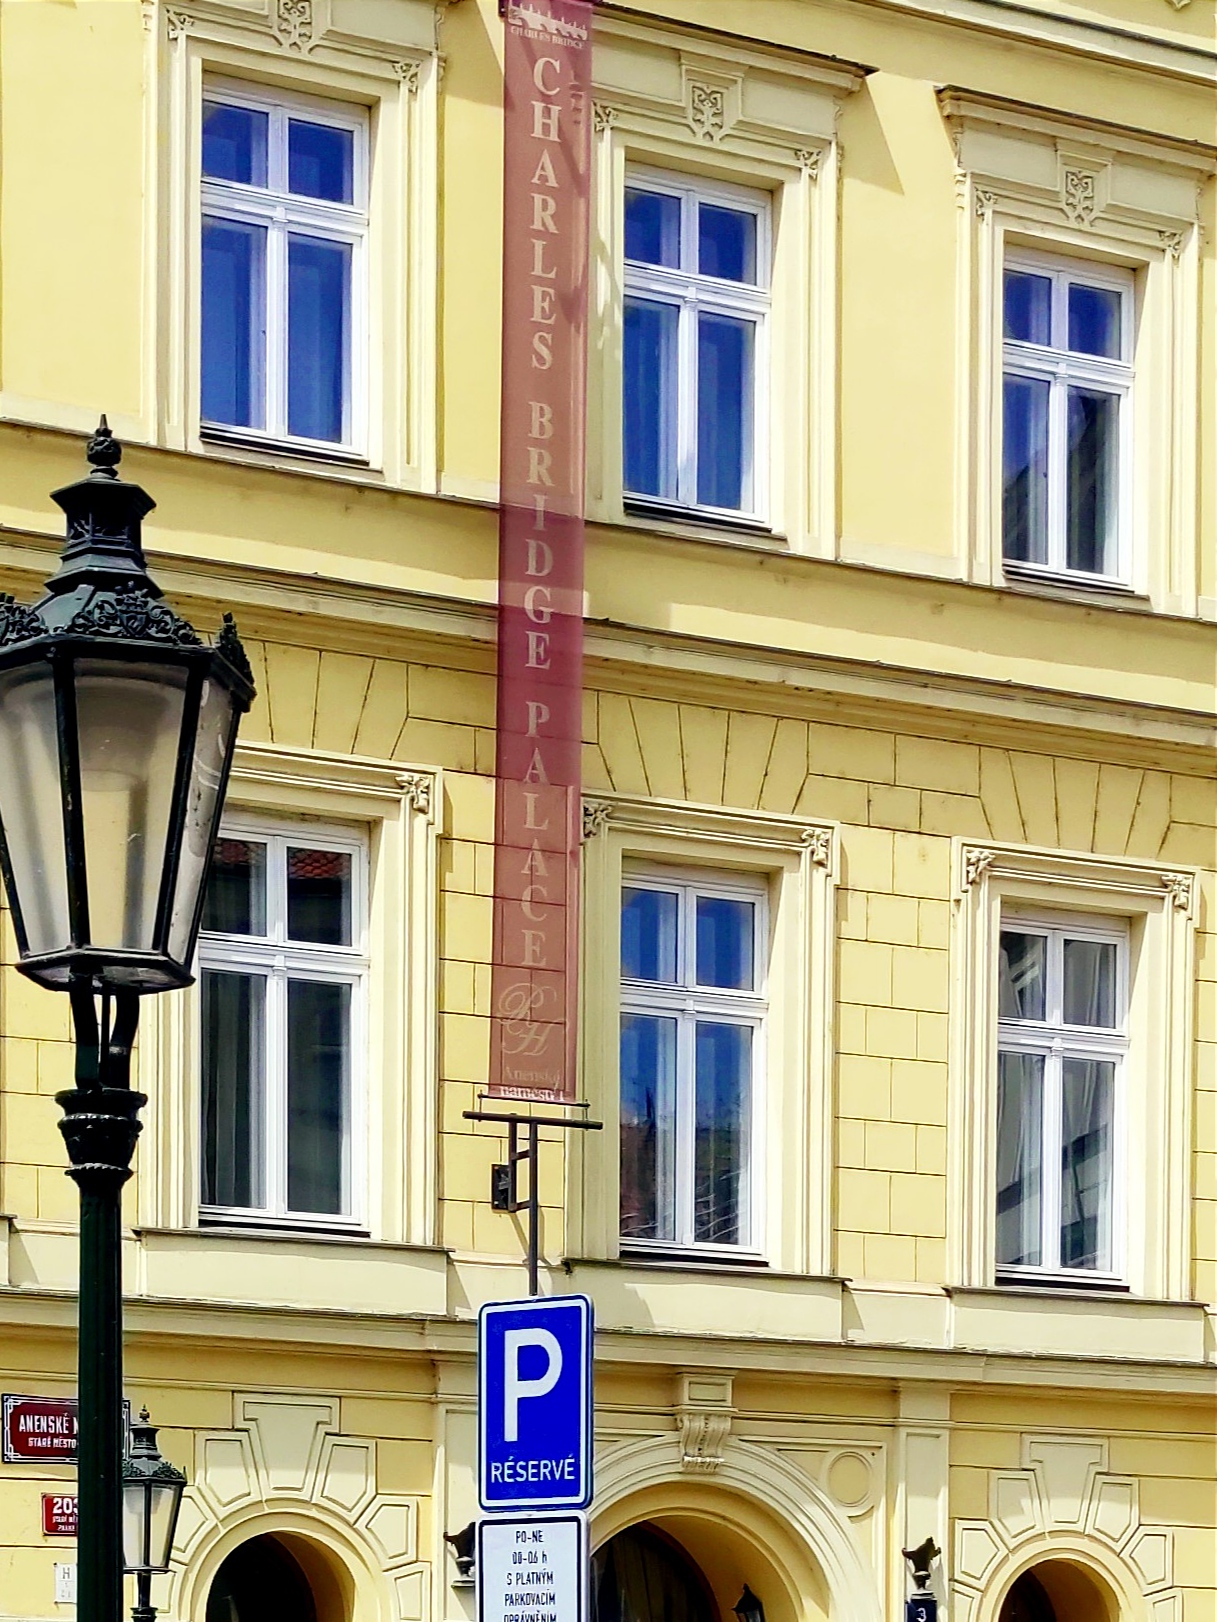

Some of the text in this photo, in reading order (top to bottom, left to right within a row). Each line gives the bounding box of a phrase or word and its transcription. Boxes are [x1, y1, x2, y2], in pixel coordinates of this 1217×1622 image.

[521, 57, 562, 967] CHARLES BRIDGE PALACE
[504, 1327, 563, 1442] P
[18, 1412, 70, 1435] ANENSKÉ
[491, 1453, 575, 1484] RÉSERVÉ
[515, 1530, 544, 1544] PO-NE
[541, 1551, 548, 1564] h
[62, 1567, 70, 1579] H
[506, 1568, 554, 1586] S PLATNÝM
[504, 1589, 556, 1607] PARKOVACÍM
[916, 1607, 927, 1622] 3
